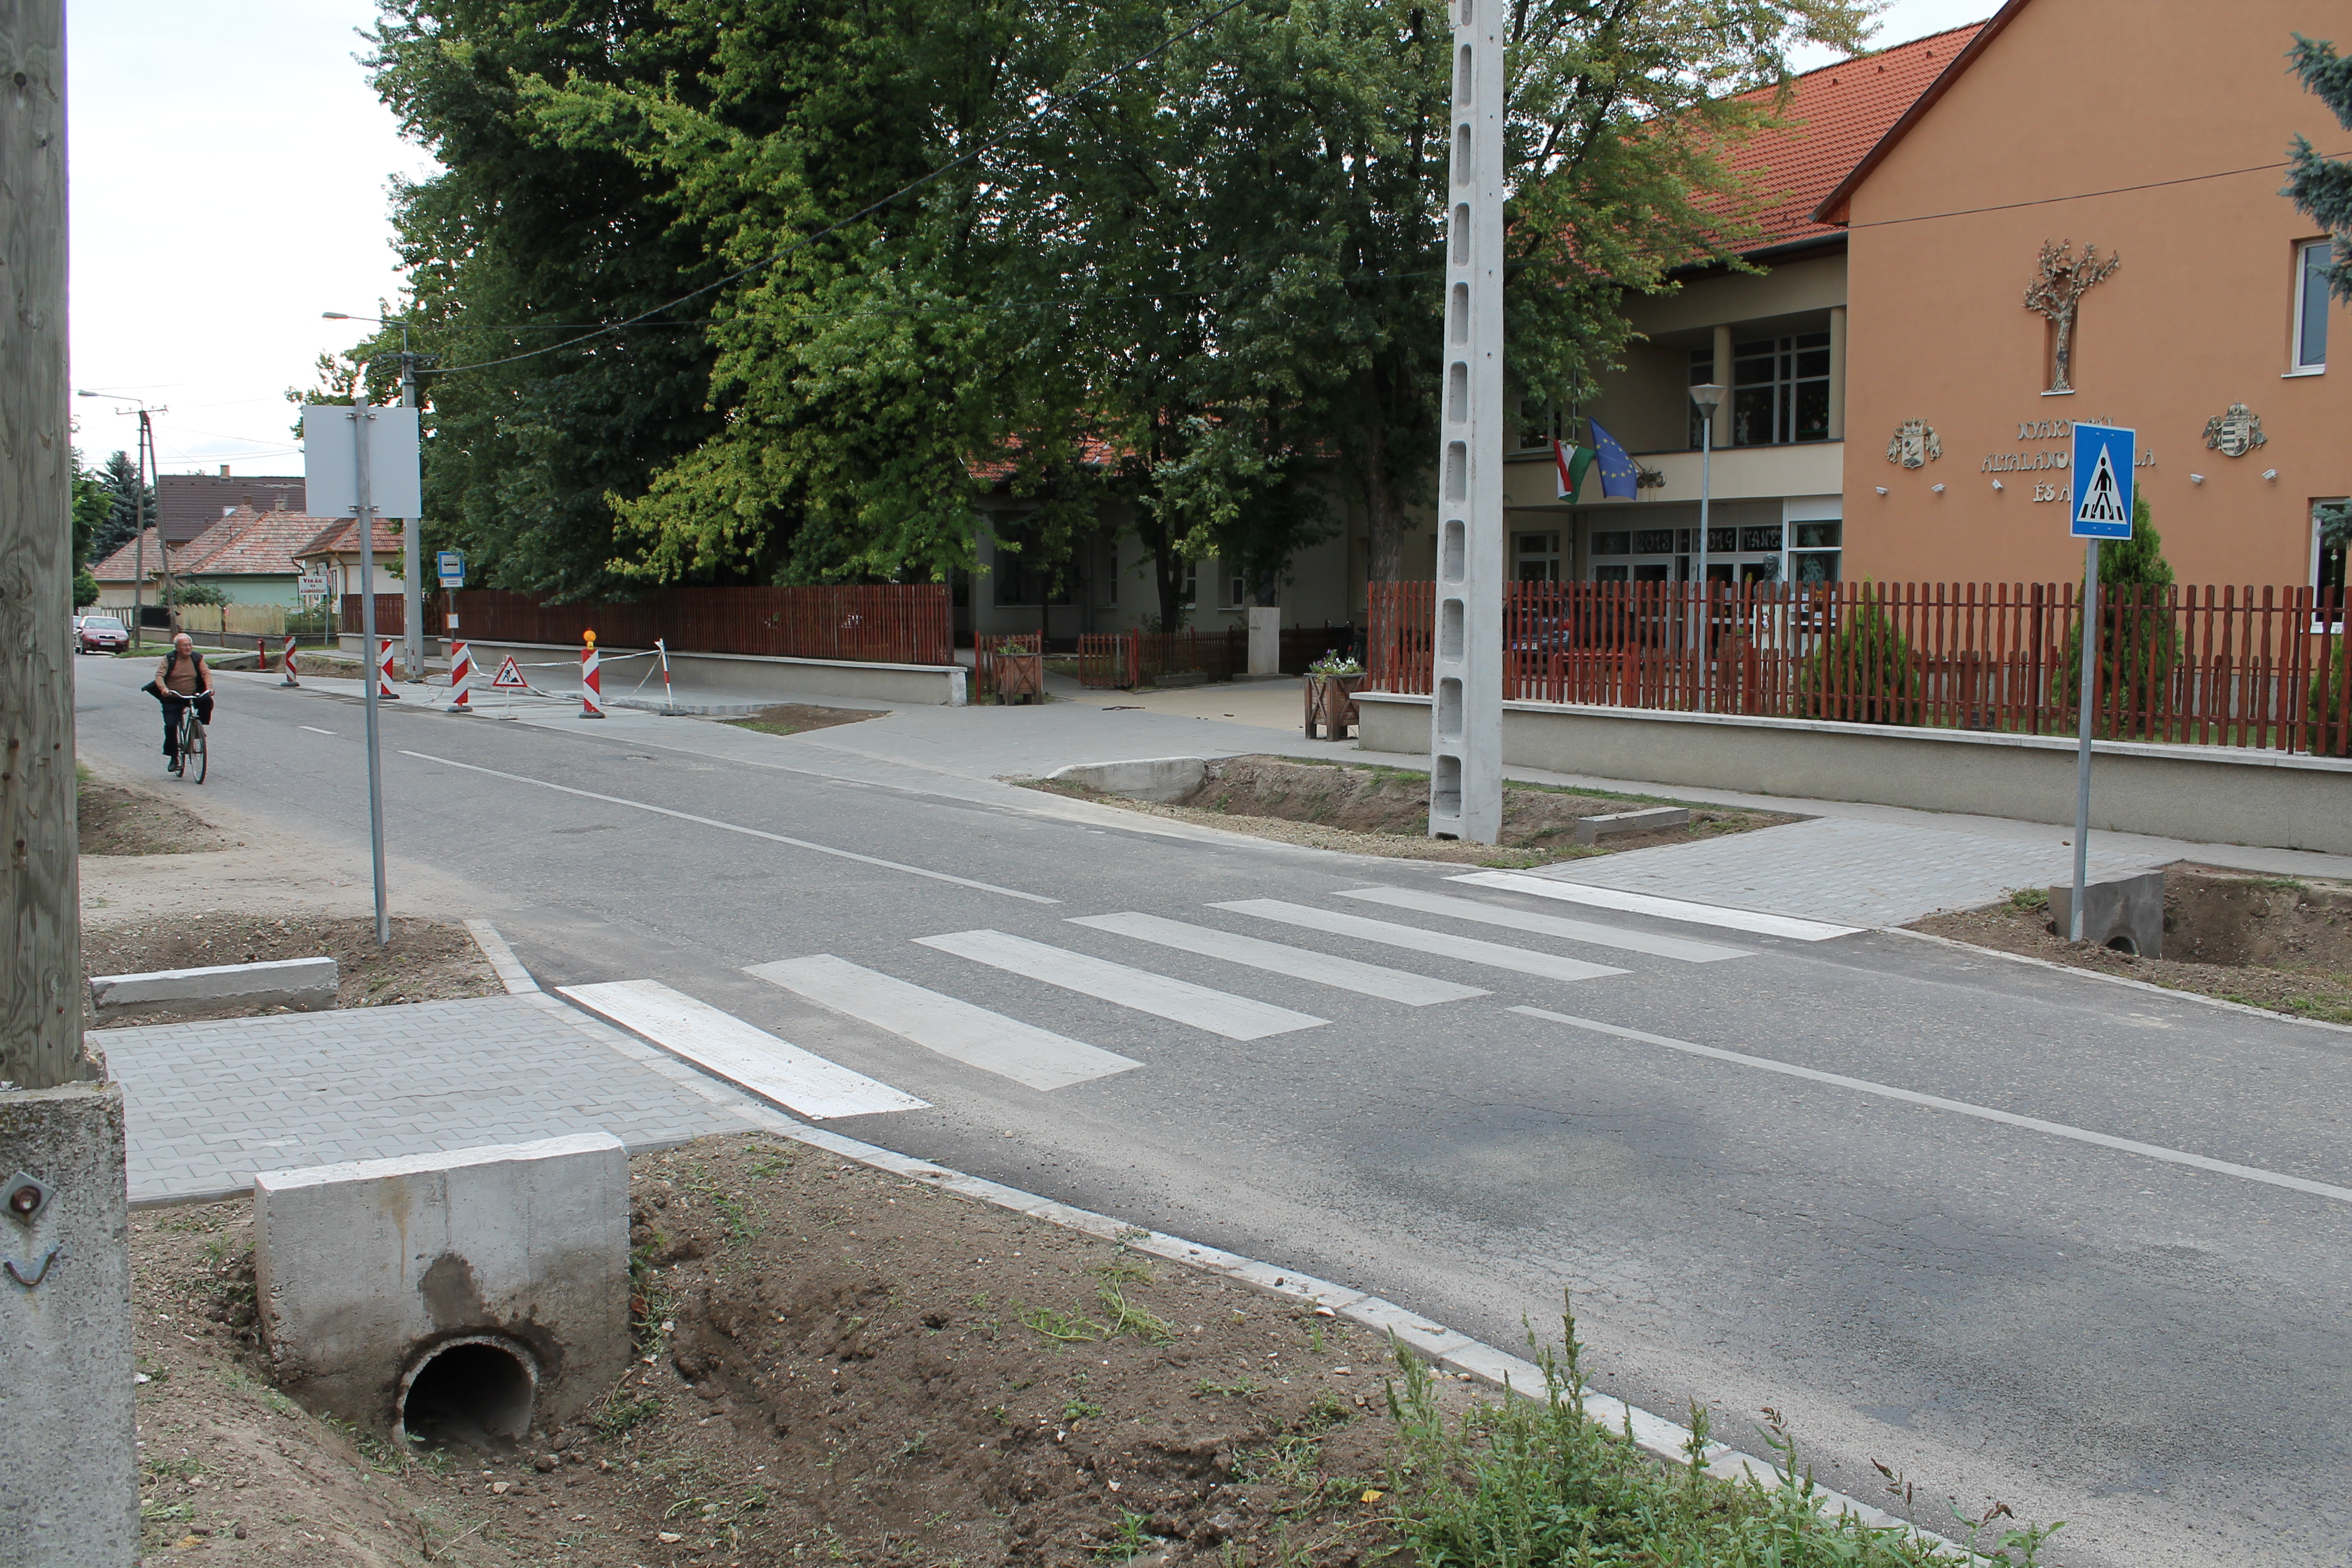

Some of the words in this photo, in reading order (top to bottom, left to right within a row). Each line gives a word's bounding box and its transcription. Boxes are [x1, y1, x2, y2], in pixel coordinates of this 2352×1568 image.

[2017, 418, 2075, 440] NYÁRY
[1981, 449, 2072, 472] ÁLTALÁNO
[2033, 479, 2056, 502] ÉS
[1637, 533, 1670, 551] 2013
[1698, 531, 1733, 548] 014
